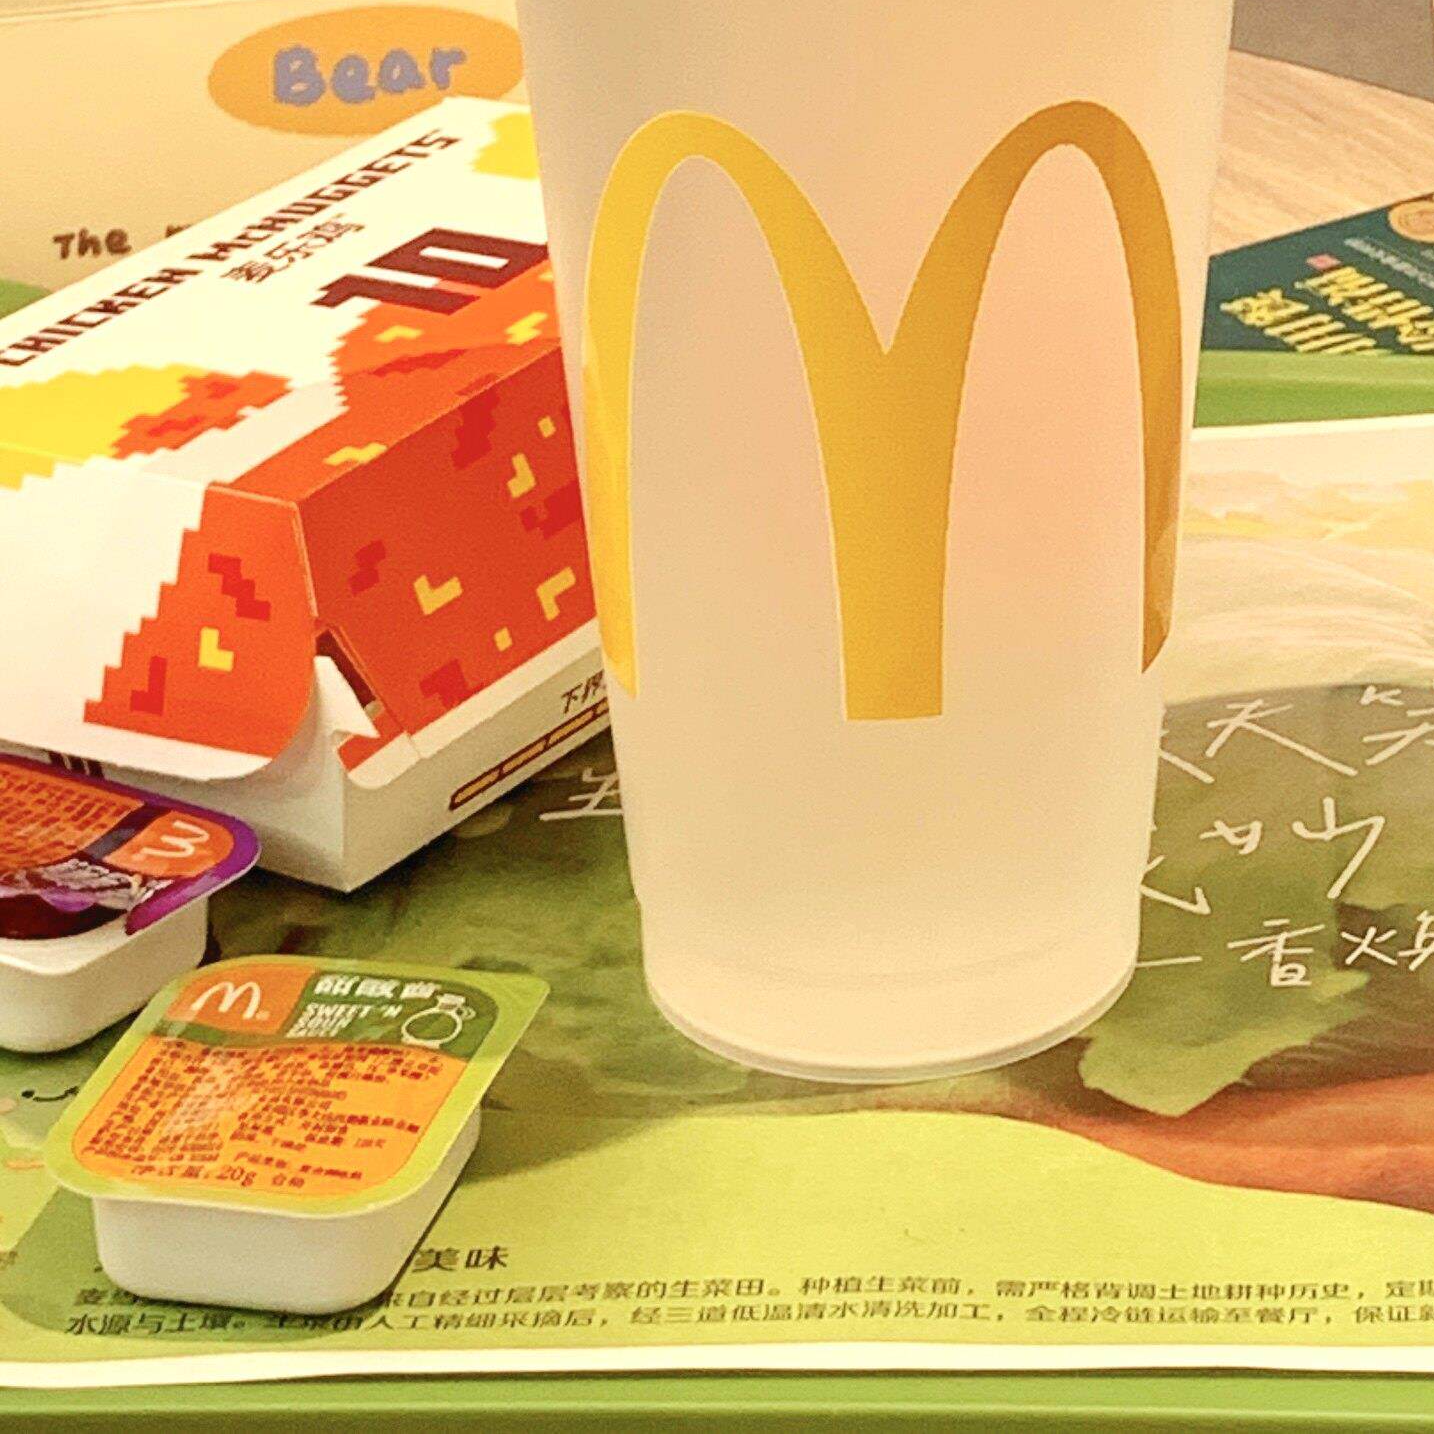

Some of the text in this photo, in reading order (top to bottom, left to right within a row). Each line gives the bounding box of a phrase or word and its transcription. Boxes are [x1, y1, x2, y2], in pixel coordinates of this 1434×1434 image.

[272, 44, 467, 107] Bear
[53, 228, 132, 260] The
[310, 227, 549, 316] 10
